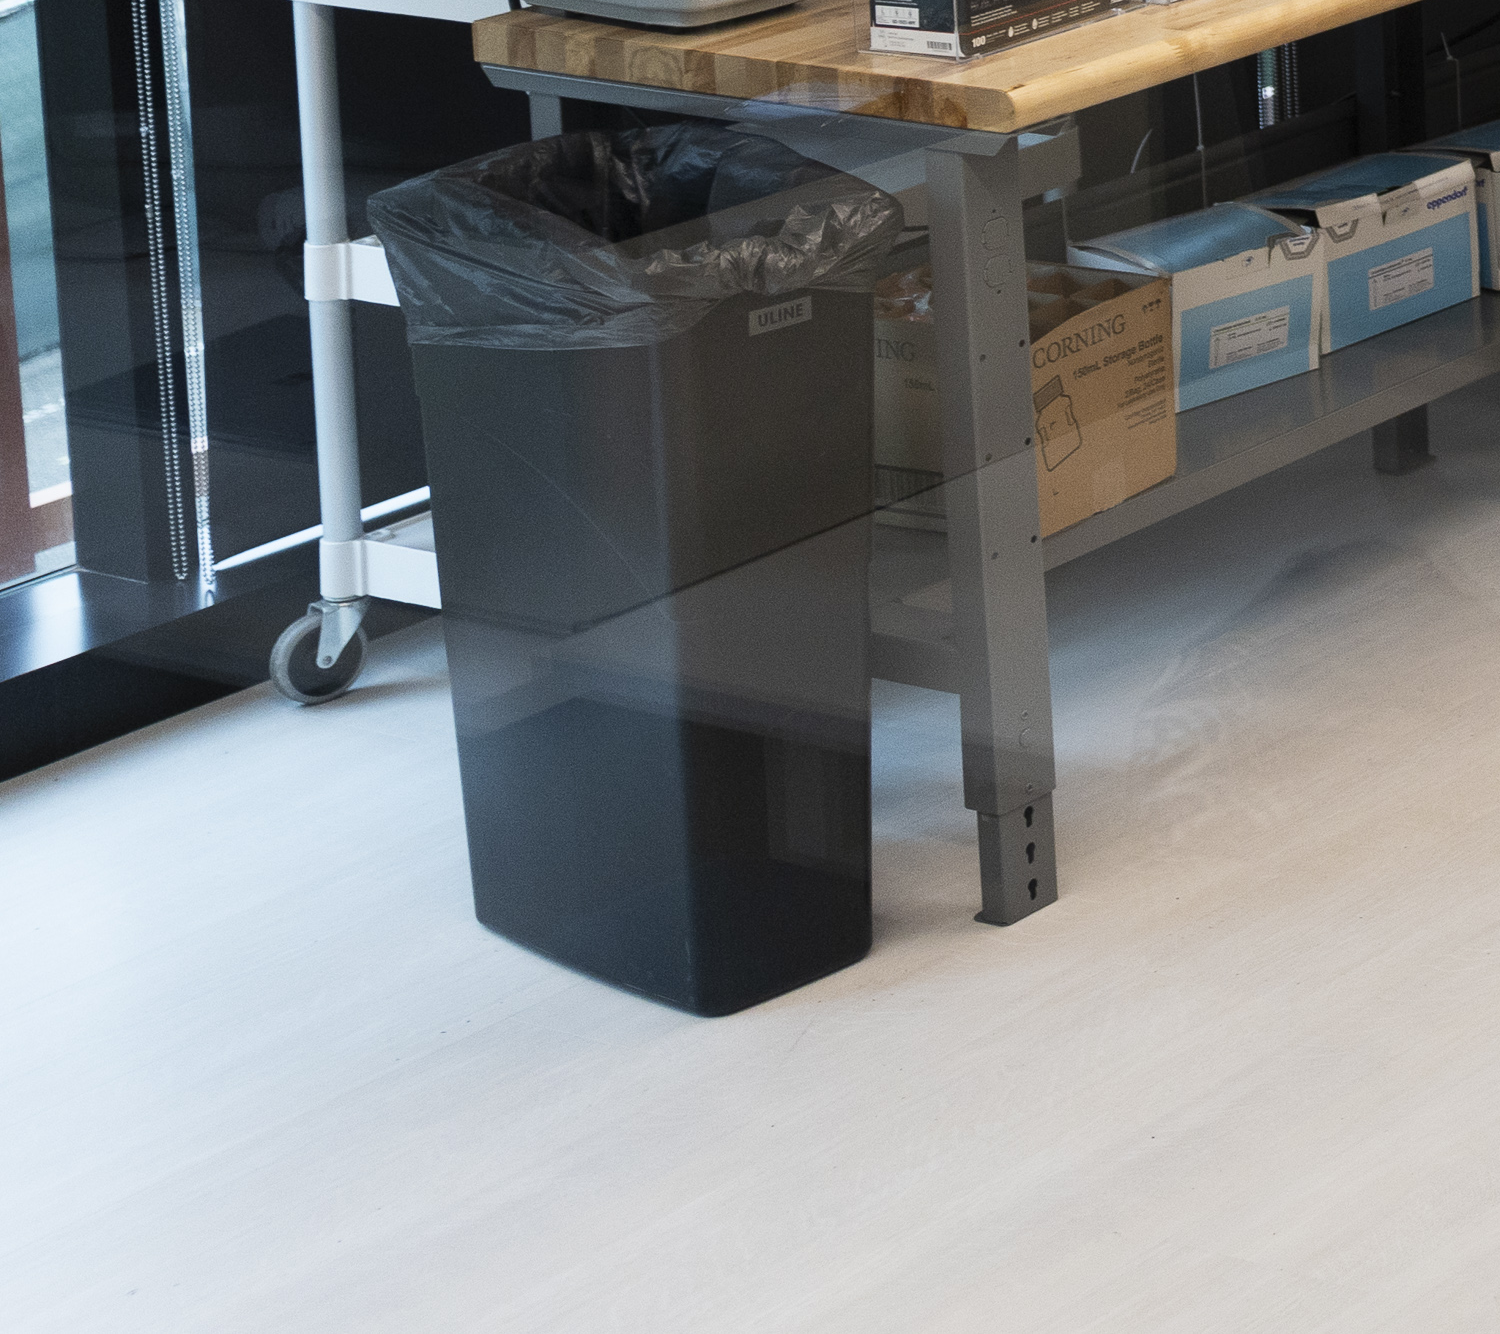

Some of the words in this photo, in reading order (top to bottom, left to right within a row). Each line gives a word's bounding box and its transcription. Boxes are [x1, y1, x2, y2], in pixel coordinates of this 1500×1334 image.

[971, 35, 986, 48] 100
[1426, 186, 1469, 211] eppendorf
[757, 302, 804, 328] ULINE
[1032, 313, 1127, 369] CORNING
[1102, 346, 1138, 368] Storage
[1137, 333, 1164, 353] Bottle
